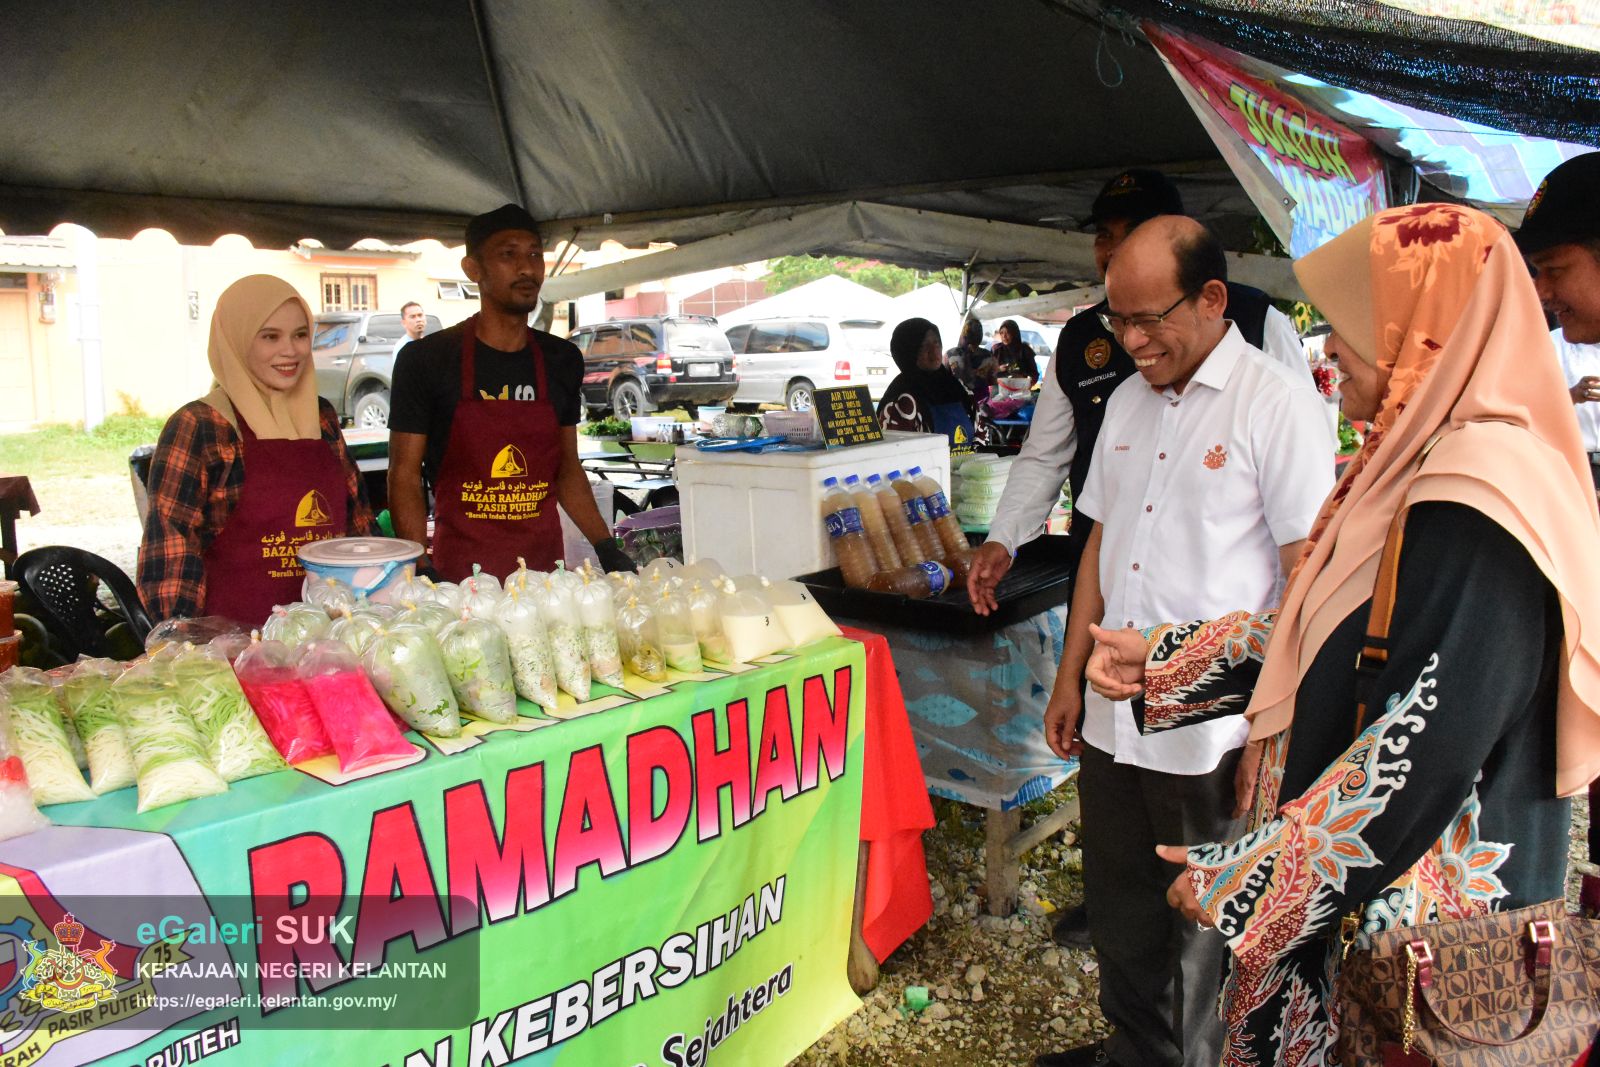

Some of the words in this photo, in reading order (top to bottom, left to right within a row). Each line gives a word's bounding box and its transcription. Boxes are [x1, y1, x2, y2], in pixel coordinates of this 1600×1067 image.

[831, 391, 841, 401] AIR
[842, 390, 857, 399] TUAK
[461, 491, 497, 503] BAZAR
[498, 491, 548, 503] RAMADHAN
[477, 503, 507, 513] PASIR
[509, 502, 538, 513] PUTEH
[247, 664, 853, 1021] RAMADHAN
[154, 943, 173, 965] 75
[468, 874, 786, 1067] KEBERSIHAN
[48, 1007, 93, 1039] PASIR
[99, 989, 149, 1020] PUTEH
[661, 964, 793, 1067] Sejahtera
